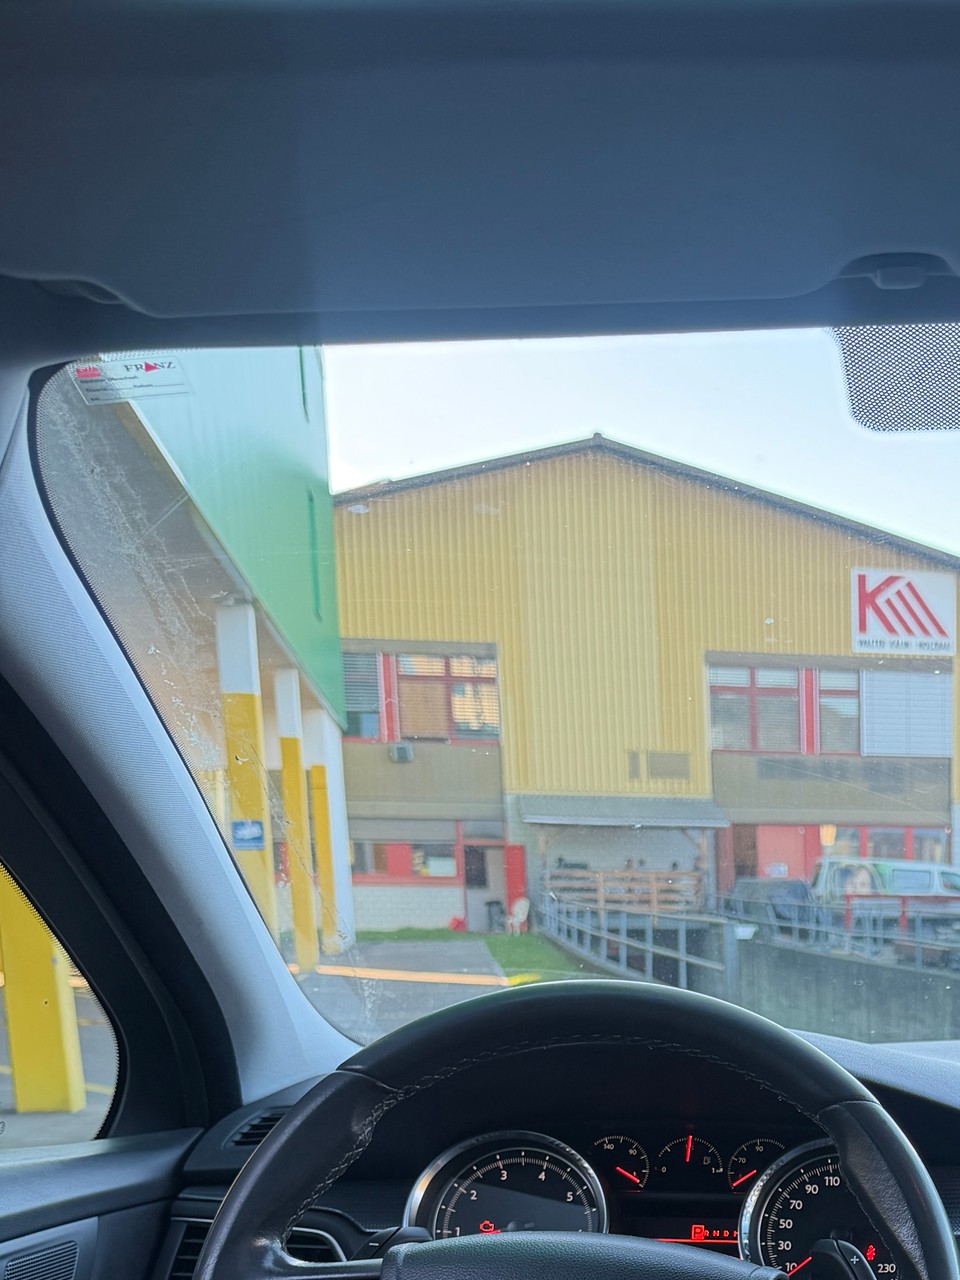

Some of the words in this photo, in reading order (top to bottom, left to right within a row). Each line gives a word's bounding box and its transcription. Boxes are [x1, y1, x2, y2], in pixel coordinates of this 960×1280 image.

[500, 1170, 508, 1181] 3
[538, 1170, 546, 1181] 4
[824, 1176, 841, 1187] 110
[805, 1184, 819, 1195] 90
[470, 1190, 478, 1201] 2
[566, 1191, 573, 1202] 5
[789, 1200, 803, 1210] 70
[779, 1219, 793, 1229] 50
[455, 1226, 461, 1236] 1
[778, 1241, 792, 1251] 30
[877, 1263, 896, 1273] 230
